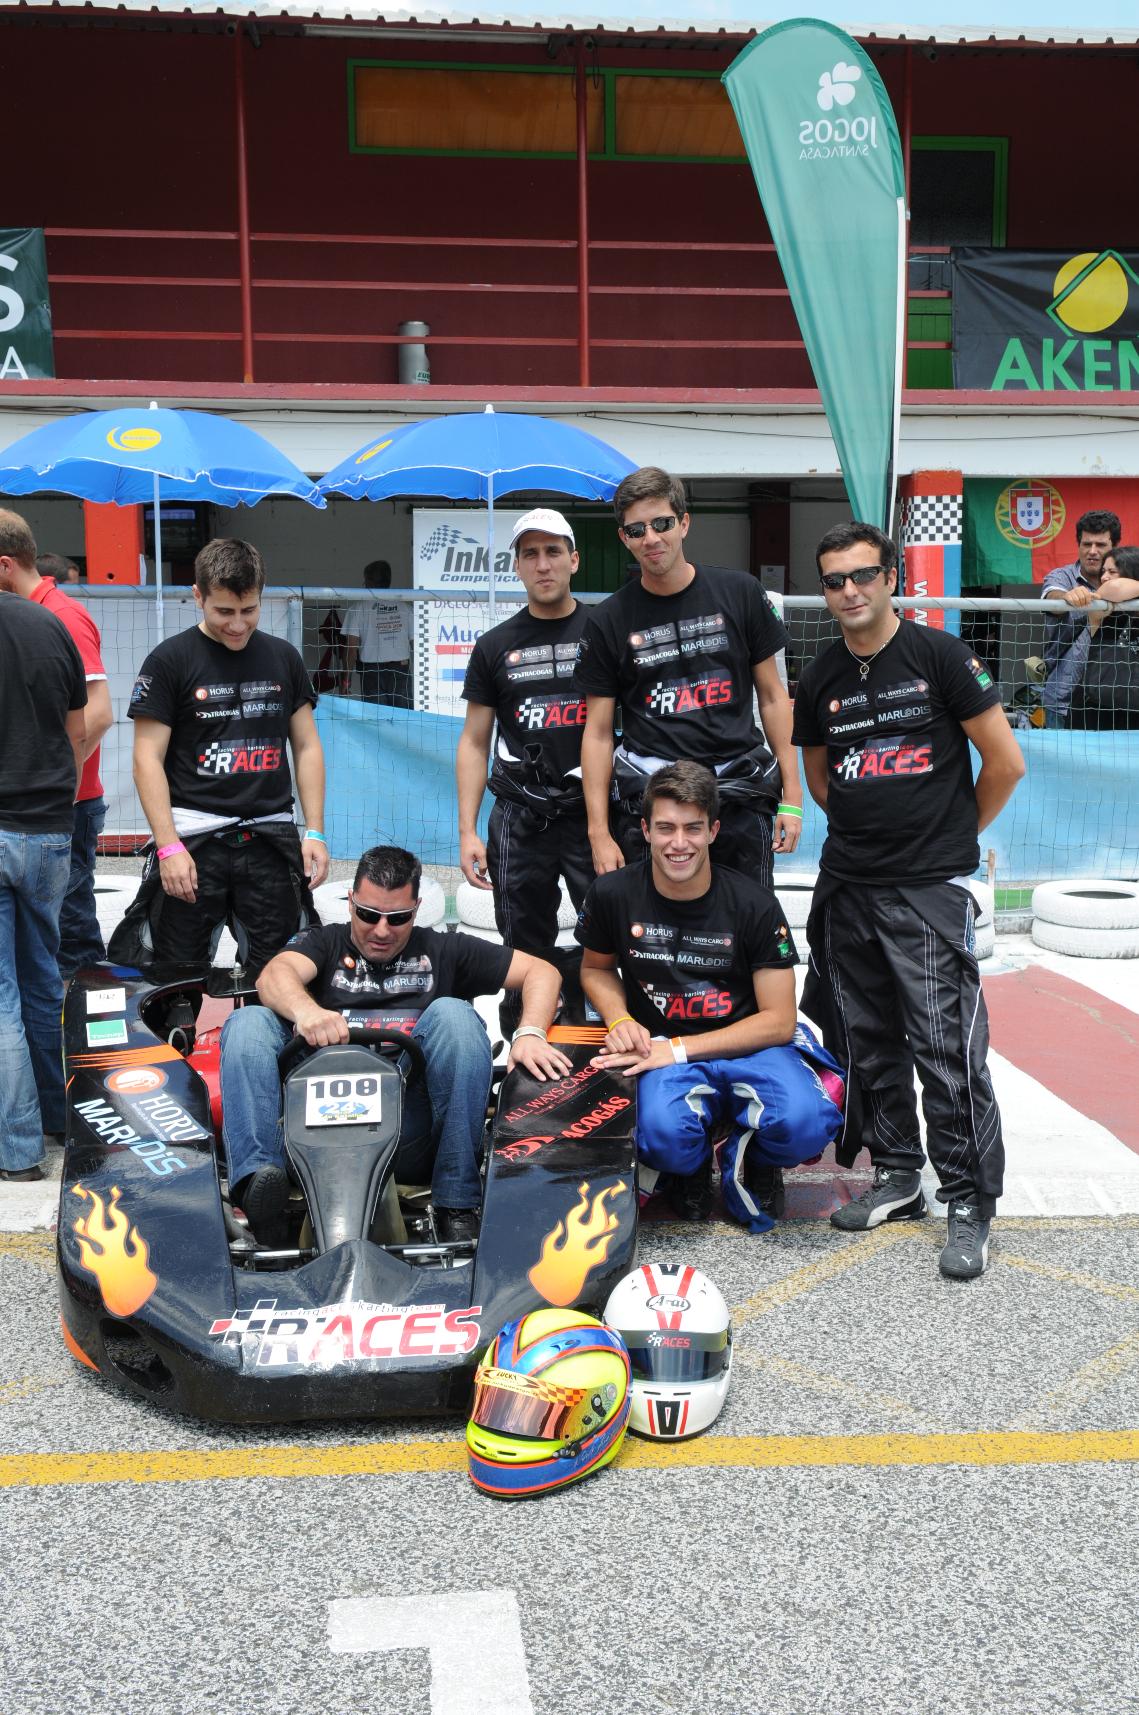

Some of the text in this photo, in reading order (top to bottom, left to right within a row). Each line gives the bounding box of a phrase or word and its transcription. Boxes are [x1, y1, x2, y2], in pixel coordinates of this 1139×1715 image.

[643, 628, 671, 640] HORUS
[521, 649, 547, 658] HORUS
[209, 687, 235, 696] HORUS
[842, 694, 868, 707] HORUS
[646, 927, 673, 938] HORUS
[310, 1077, 378, 1099] 108
[504, 1107, 533, 1124] ALL
[526, 1087, 565, 1109] WAYS
[560, 1064, 602, 1089] CARG
[139, 1093, 208, 1142] HORU
